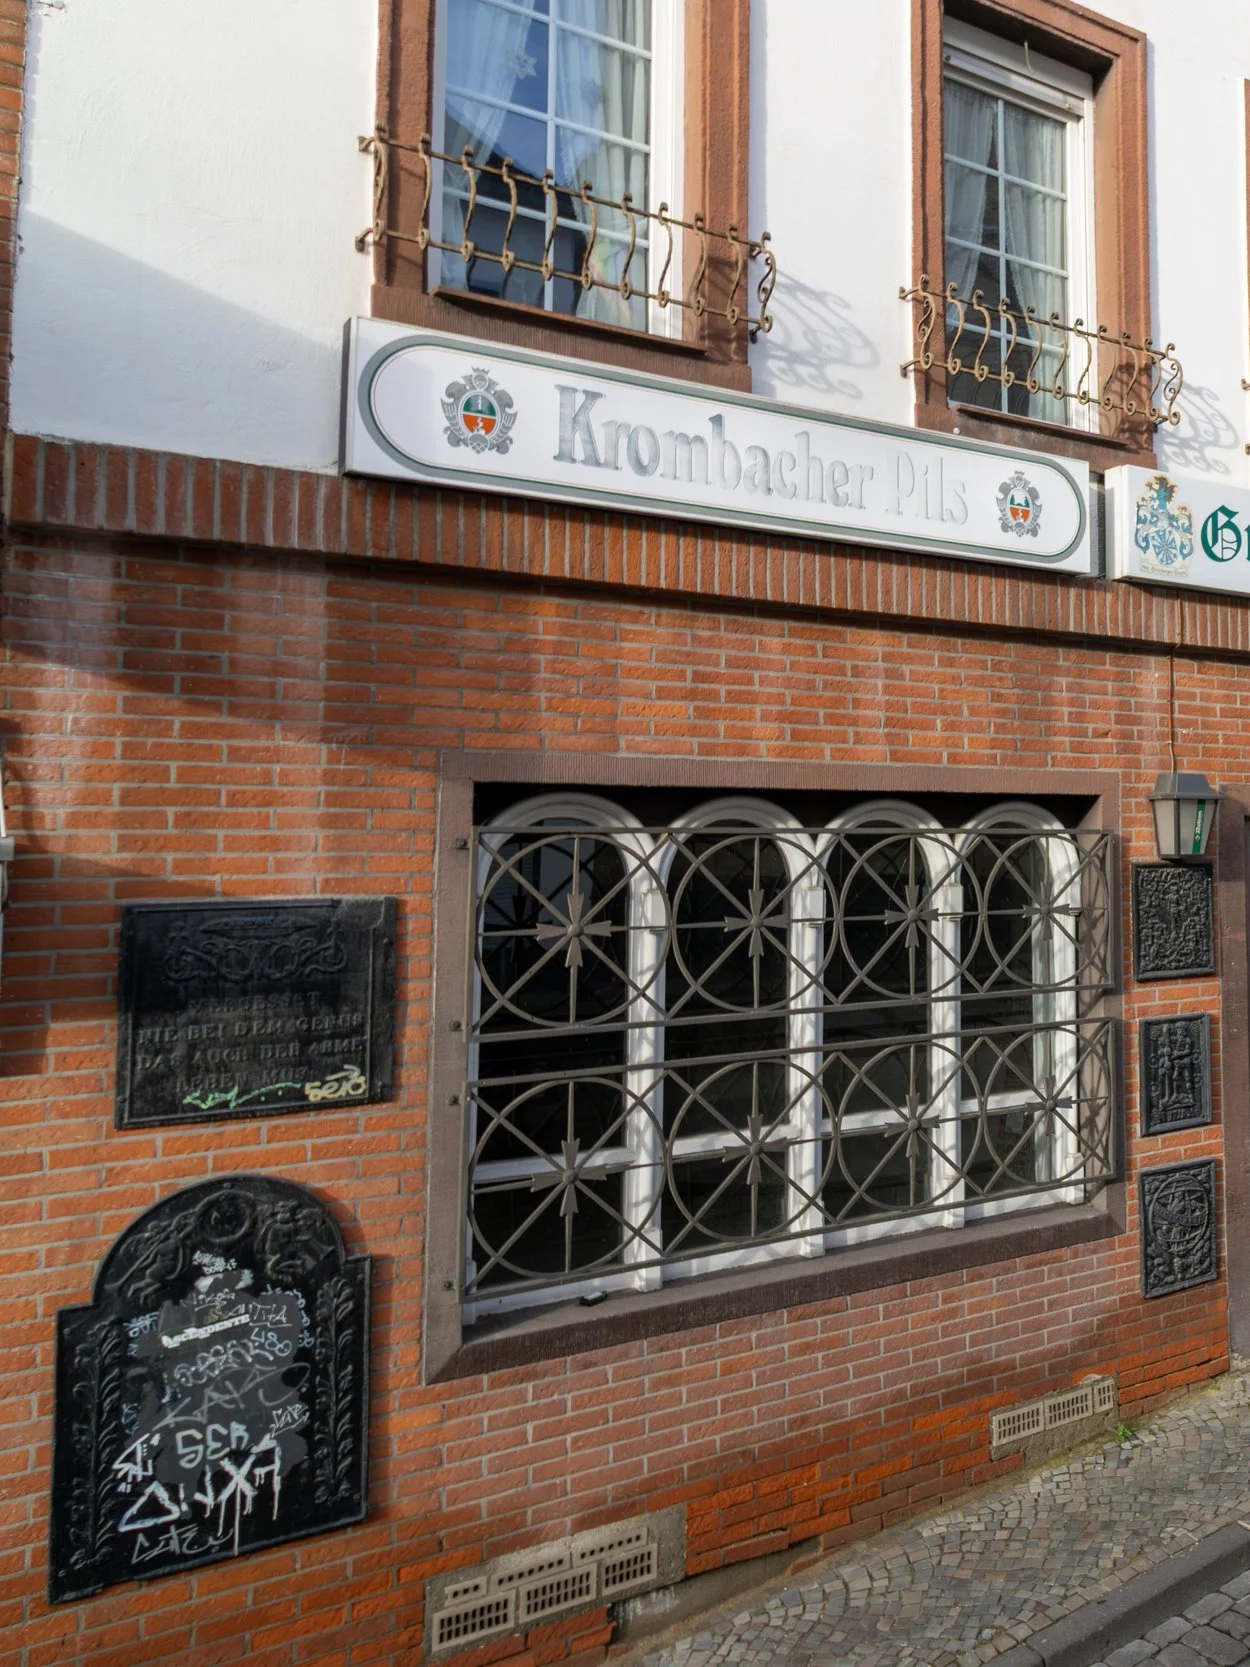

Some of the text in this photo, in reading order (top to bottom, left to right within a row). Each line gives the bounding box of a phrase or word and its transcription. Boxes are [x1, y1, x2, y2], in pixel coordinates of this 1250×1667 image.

[552, 383, 969, 527] Krombacher Pils
[187, 1023, 225, 1041] BEI
[260, 1043, 301, 1060] DER
